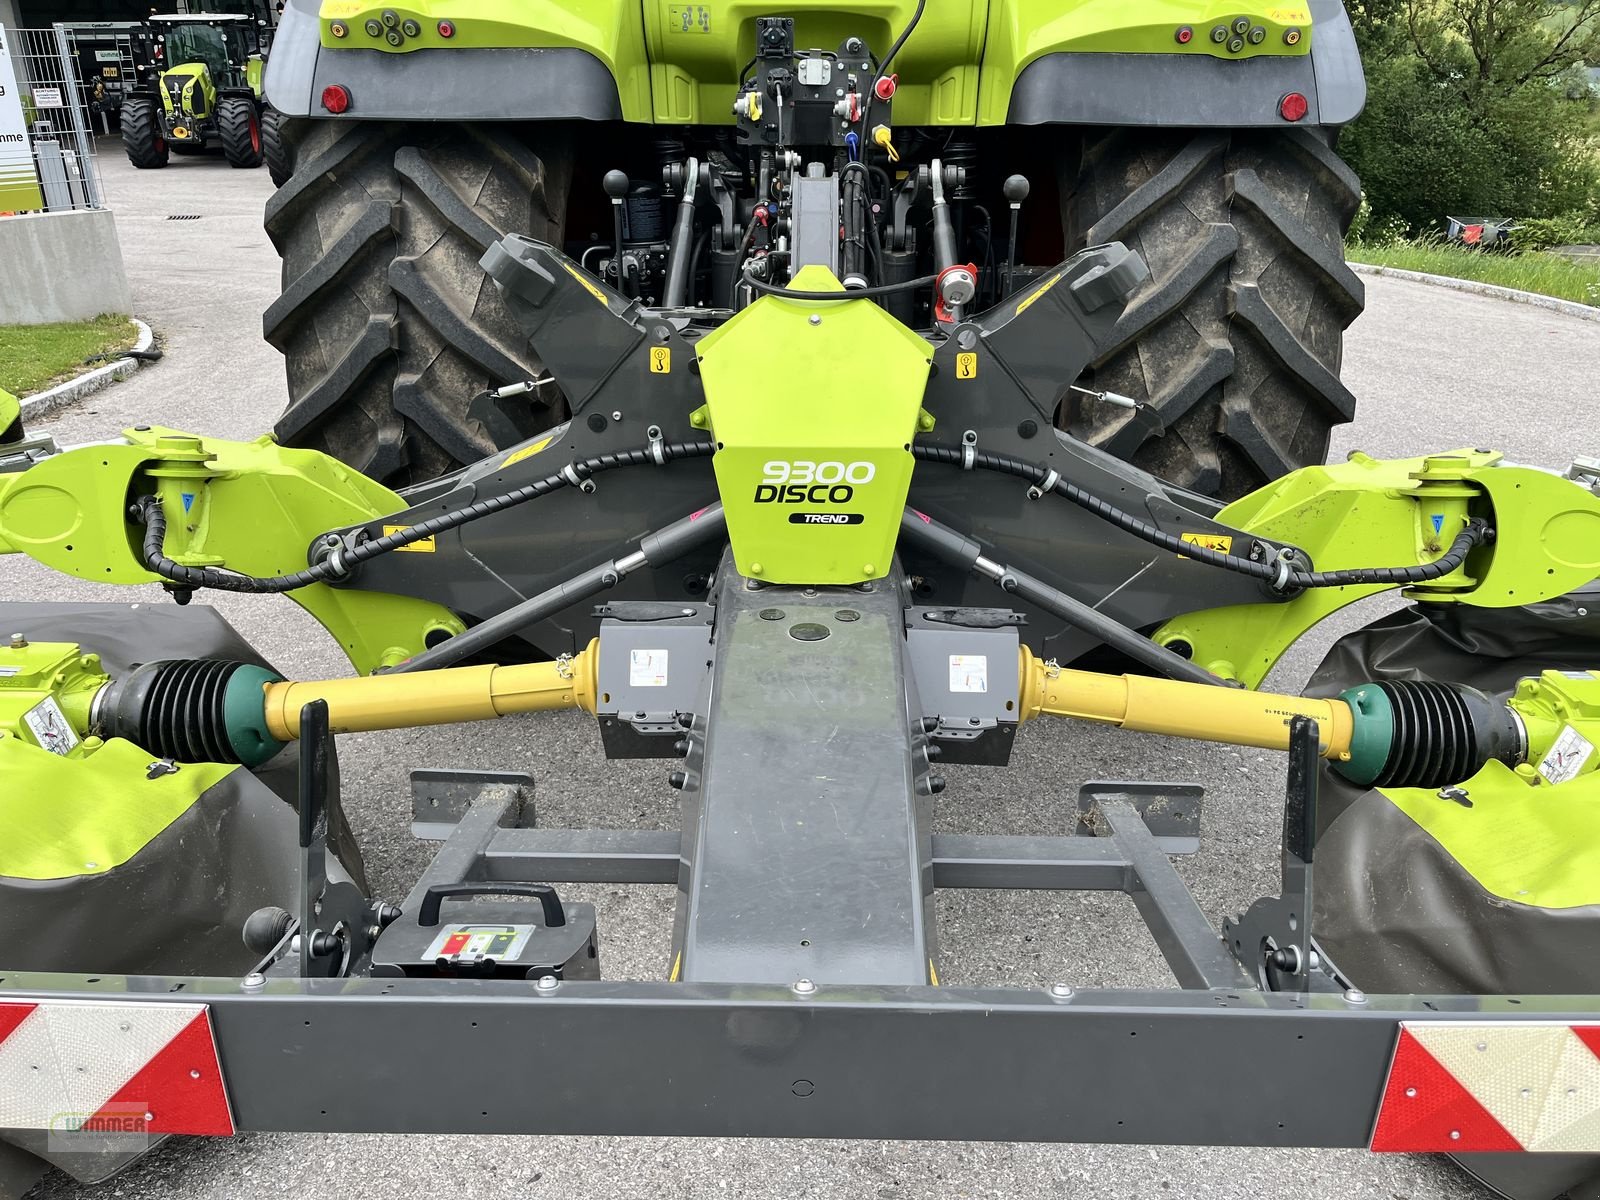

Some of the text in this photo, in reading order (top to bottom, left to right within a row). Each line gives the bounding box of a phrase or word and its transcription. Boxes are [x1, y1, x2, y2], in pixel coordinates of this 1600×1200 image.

[762, 460, 876, 484] 9300
[754, 484, 854, 504] DISCO
[804, 514, 849, 524] TREND
